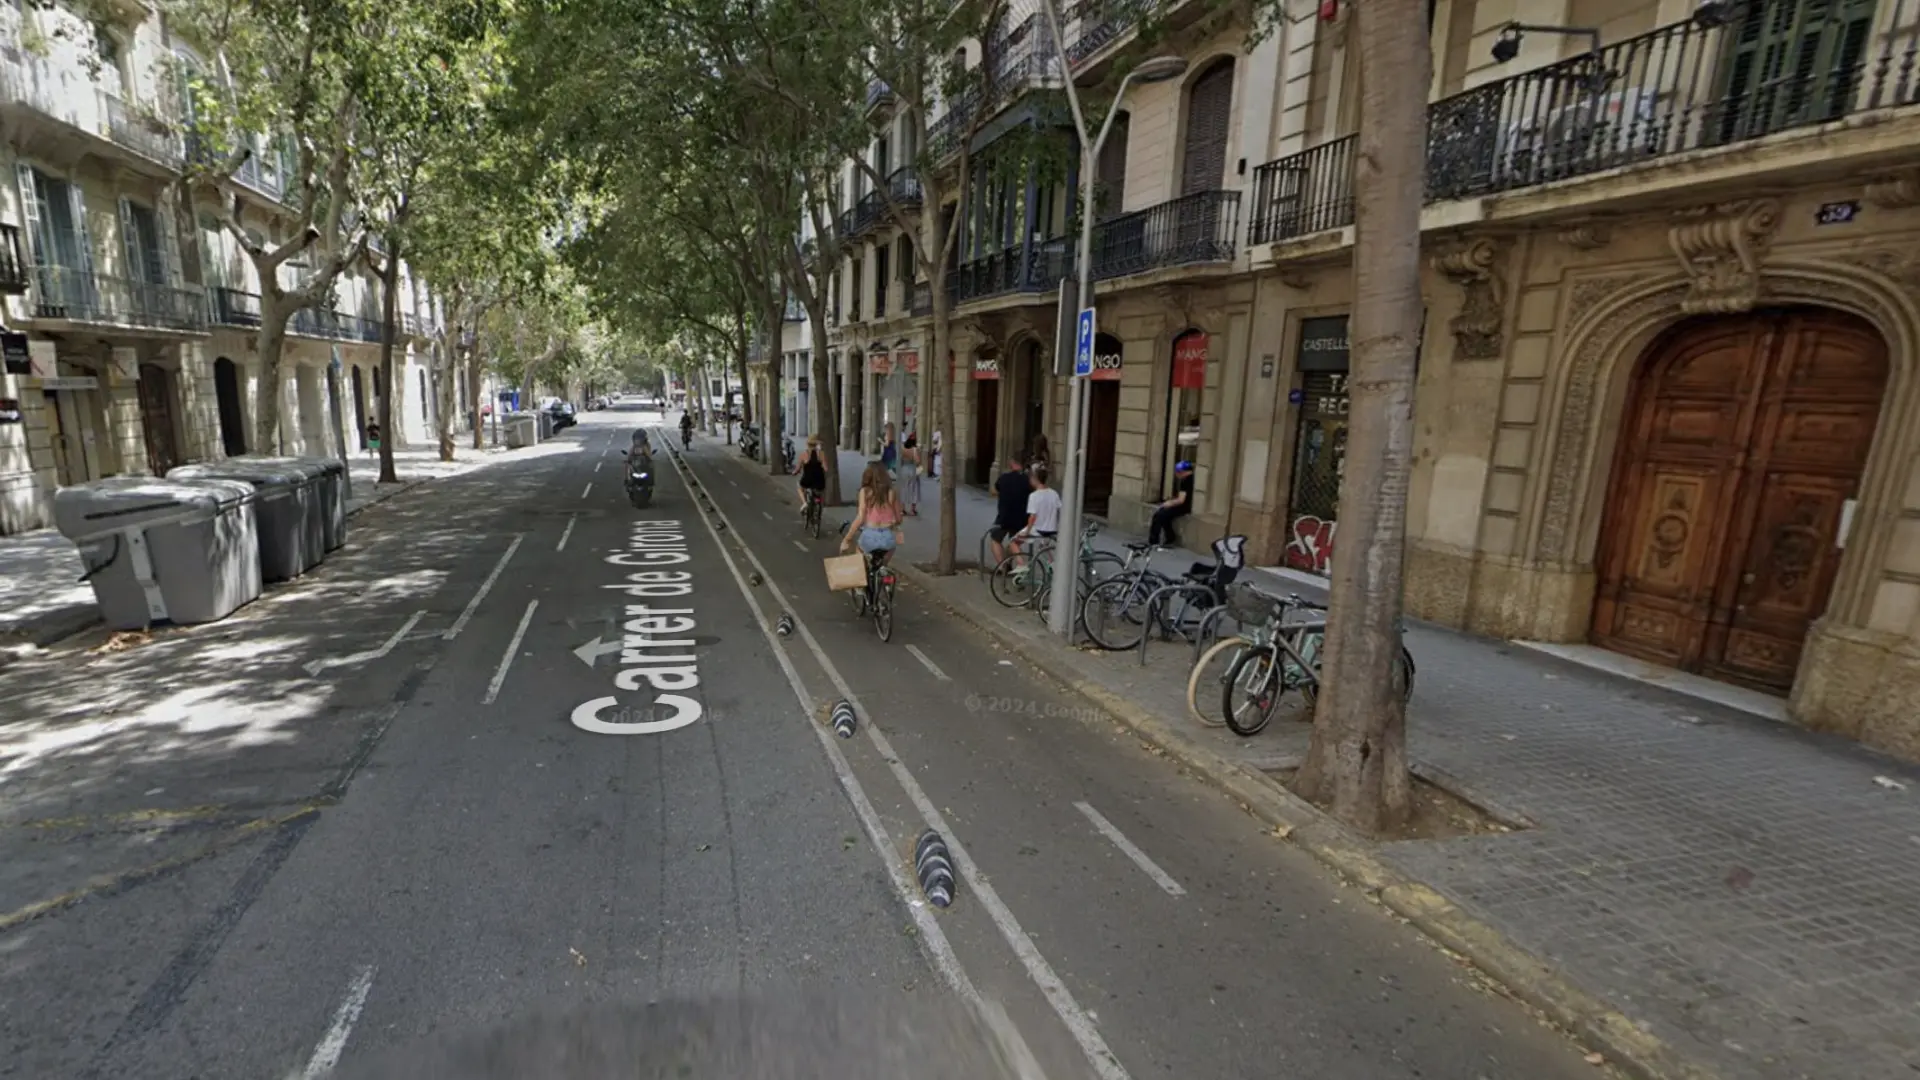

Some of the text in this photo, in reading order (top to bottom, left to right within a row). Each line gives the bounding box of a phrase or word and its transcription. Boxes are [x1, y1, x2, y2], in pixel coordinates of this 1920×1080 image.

[1081, 319, 1089, 343] P
[1095, 354, 1120, 368] NGO
[1176, 347, 1207, 360] MANG
[1330, 374, 1349, 393] TA
[1318, 397, 1349, 414] REC
